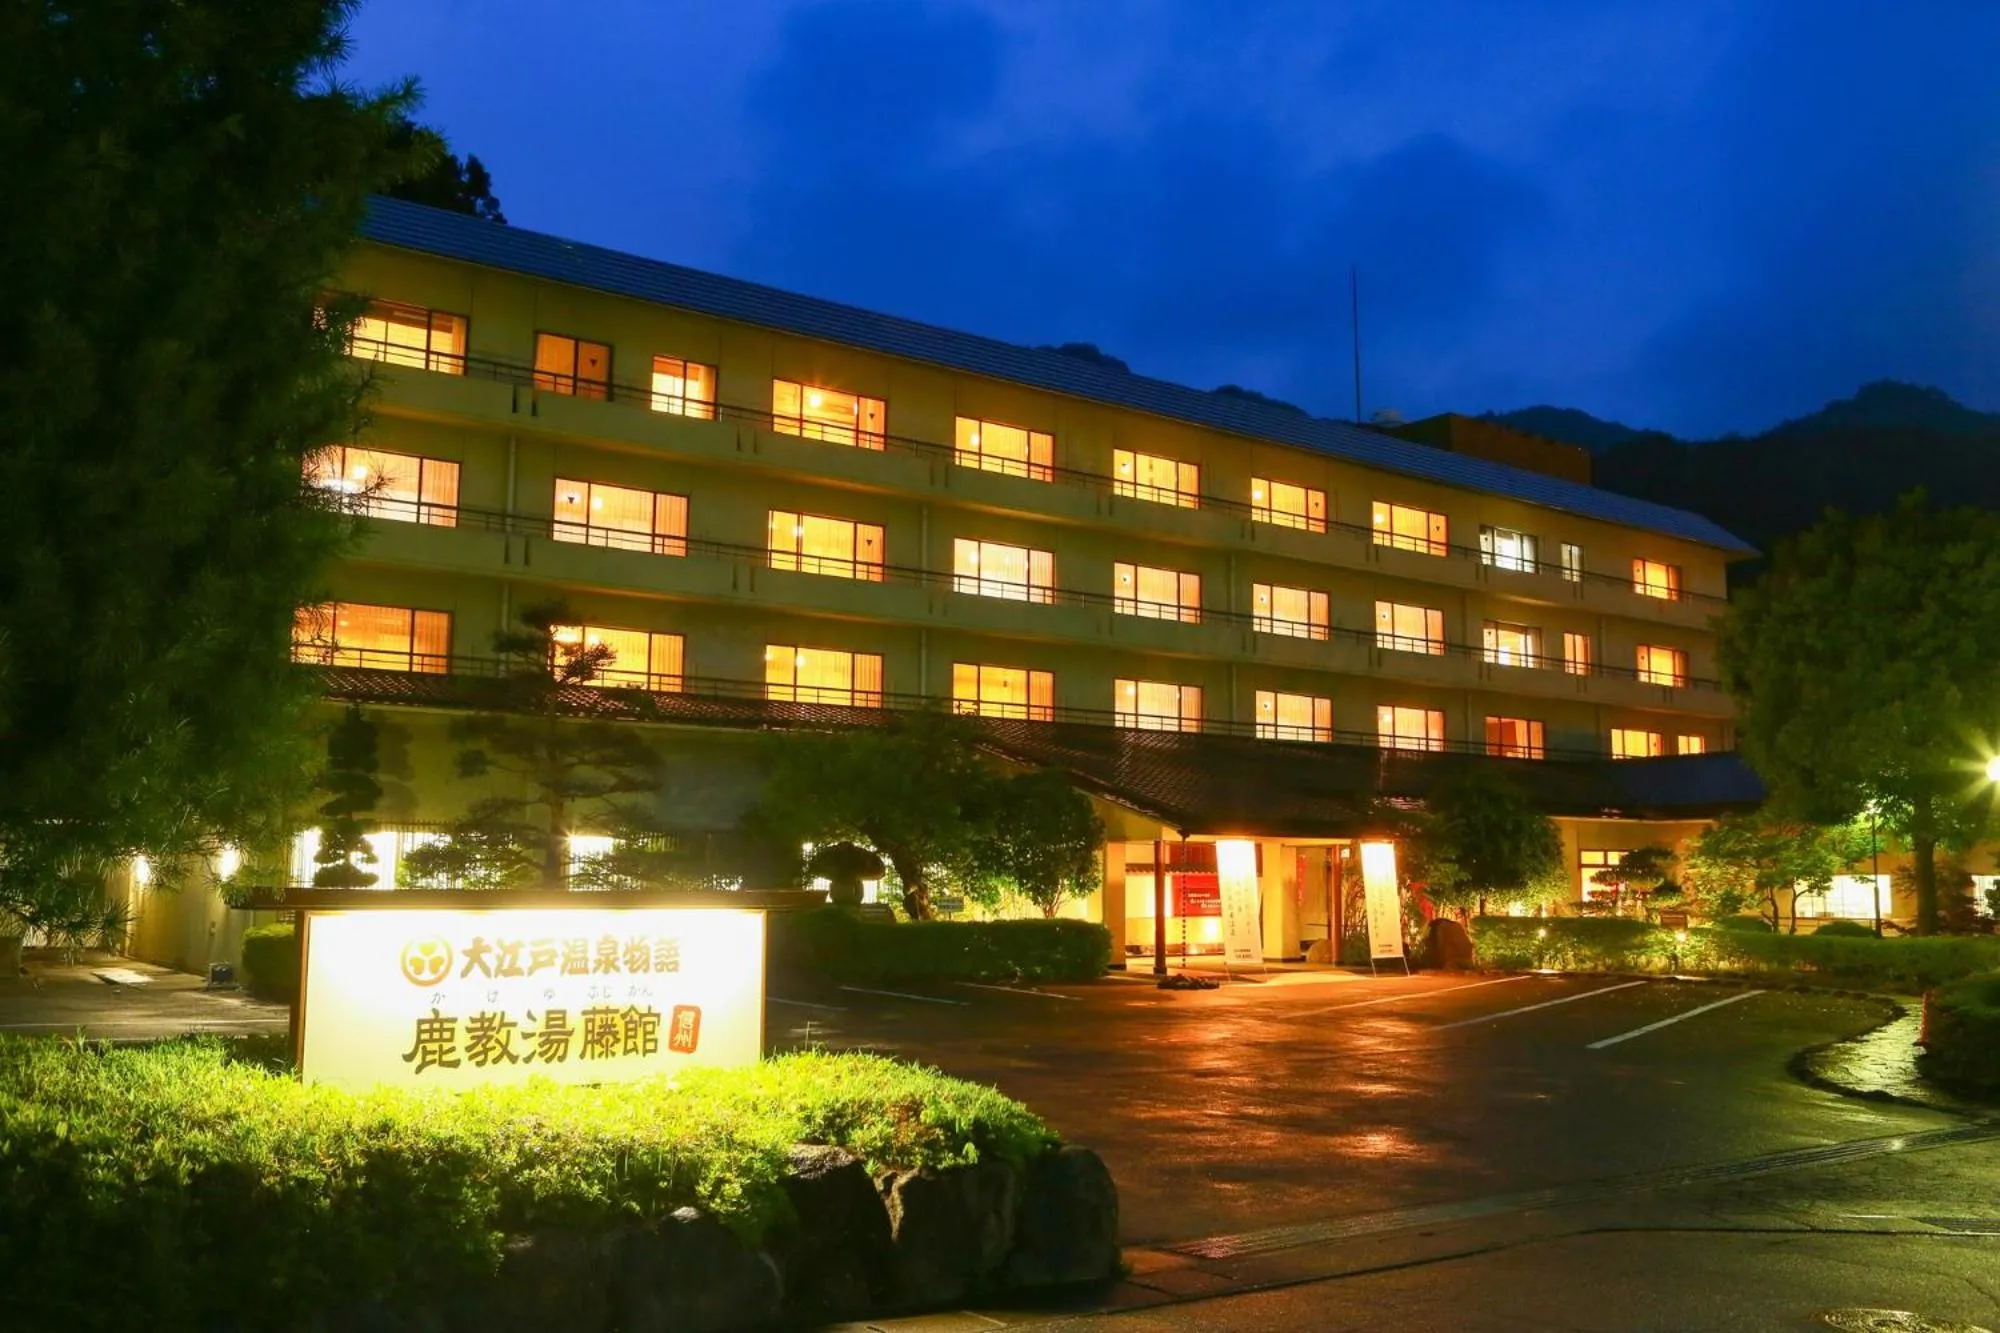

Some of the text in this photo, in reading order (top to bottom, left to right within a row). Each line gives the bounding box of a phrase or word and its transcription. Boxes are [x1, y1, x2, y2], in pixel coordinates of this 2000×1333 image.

[459, 935, 681, 979] 大江戸温泉物語
[402, 1004, 662, 1075] 鹿教湯藤館
[673, 1010, 696, 1048] 信州
